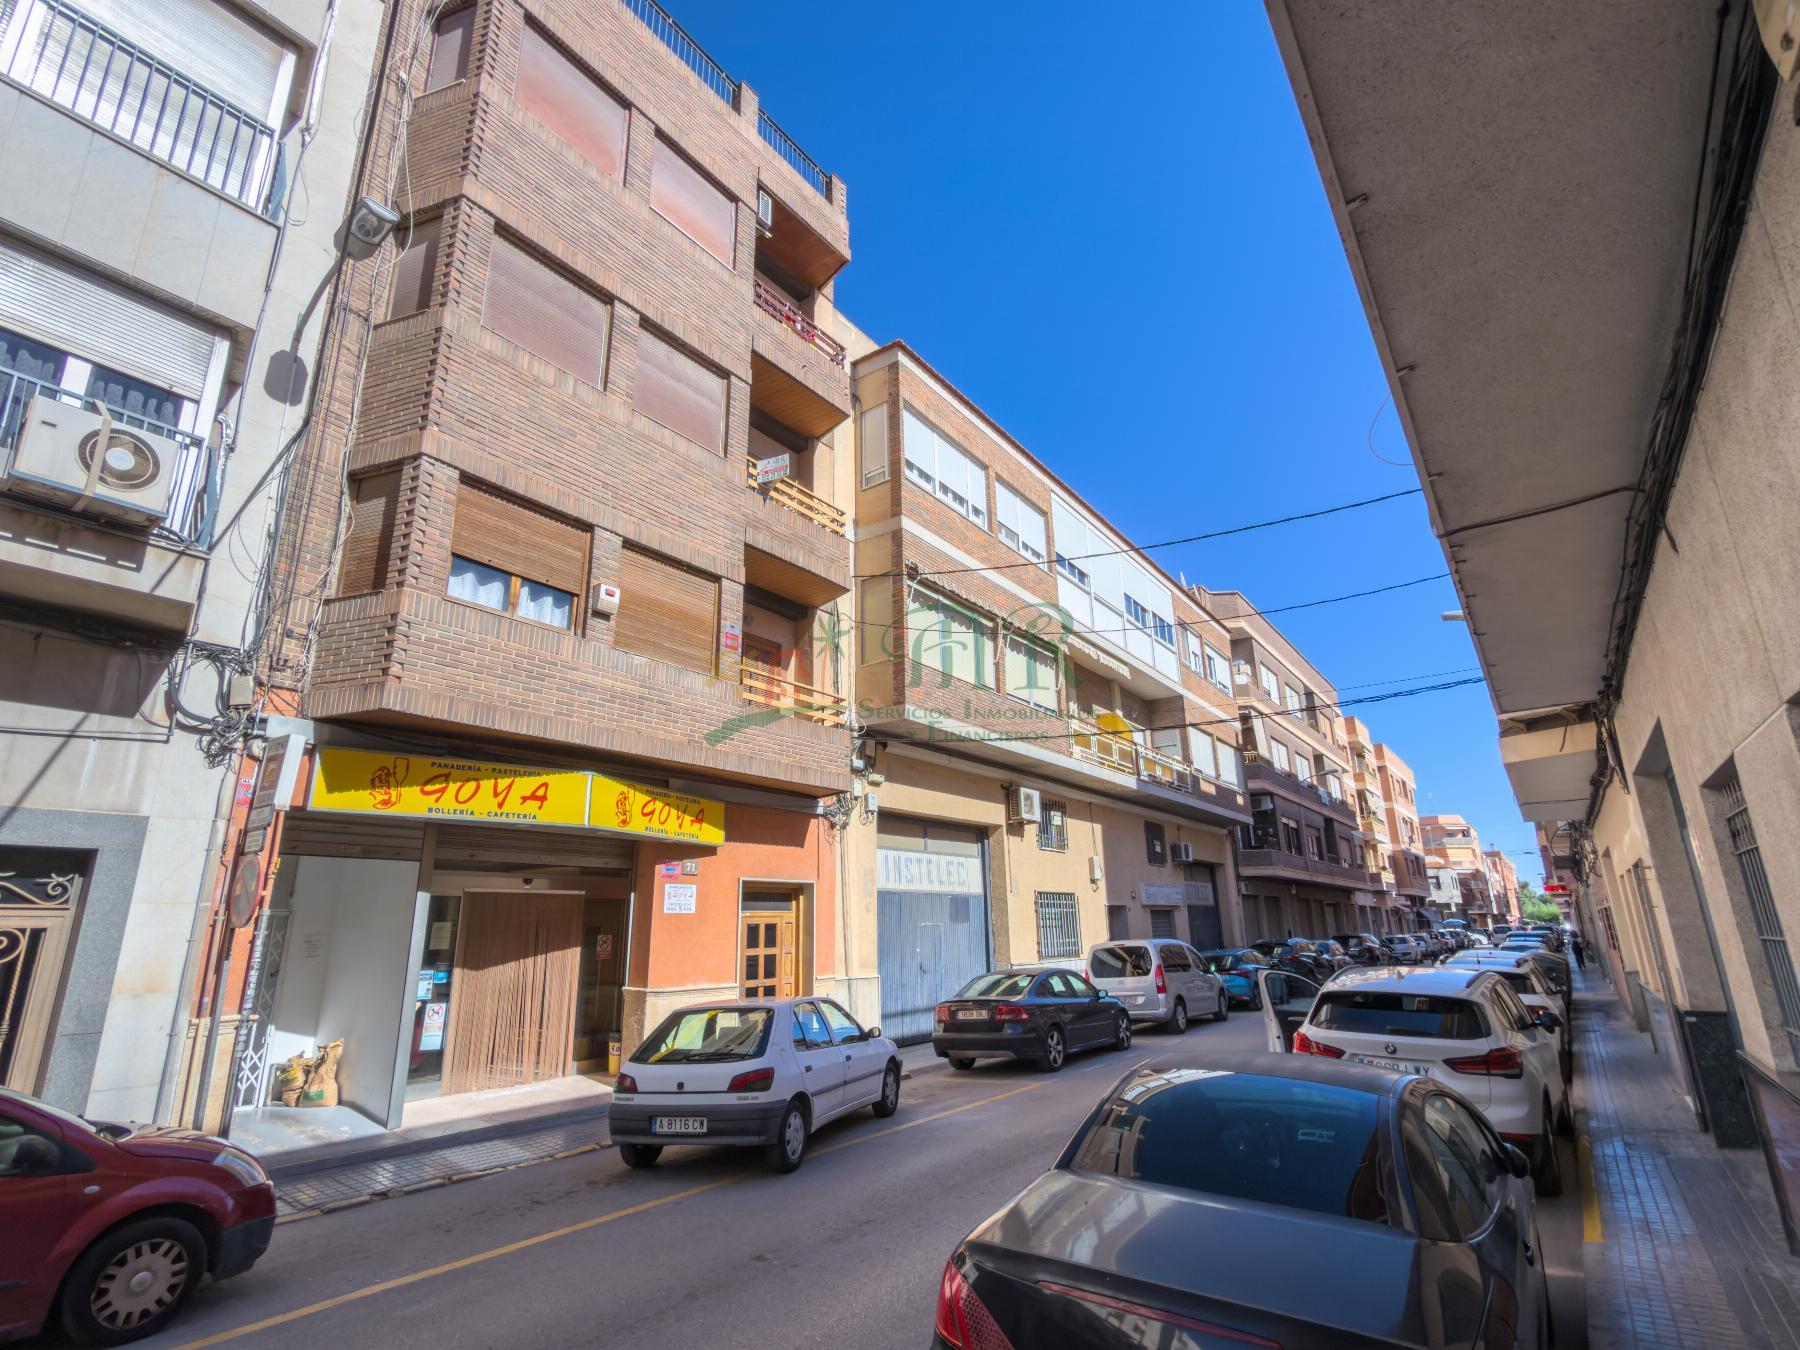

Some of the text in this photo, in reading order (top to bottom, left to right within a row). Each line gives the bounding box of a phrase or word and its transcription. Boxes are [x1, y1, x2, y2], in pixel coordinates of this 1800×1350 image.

[431, 761, 481, 773] PANADERÍA
[491, 766, 541, 777] PASTELERÍA
[419, 771, 549, 810] GOYA
[427, 806, 475, 817] BOLLERÍA
[486, 810, 538, 820] CAFETERÍA
[641, 797, 704, 831] GOYA
[686, 862, 696, 872] 71
